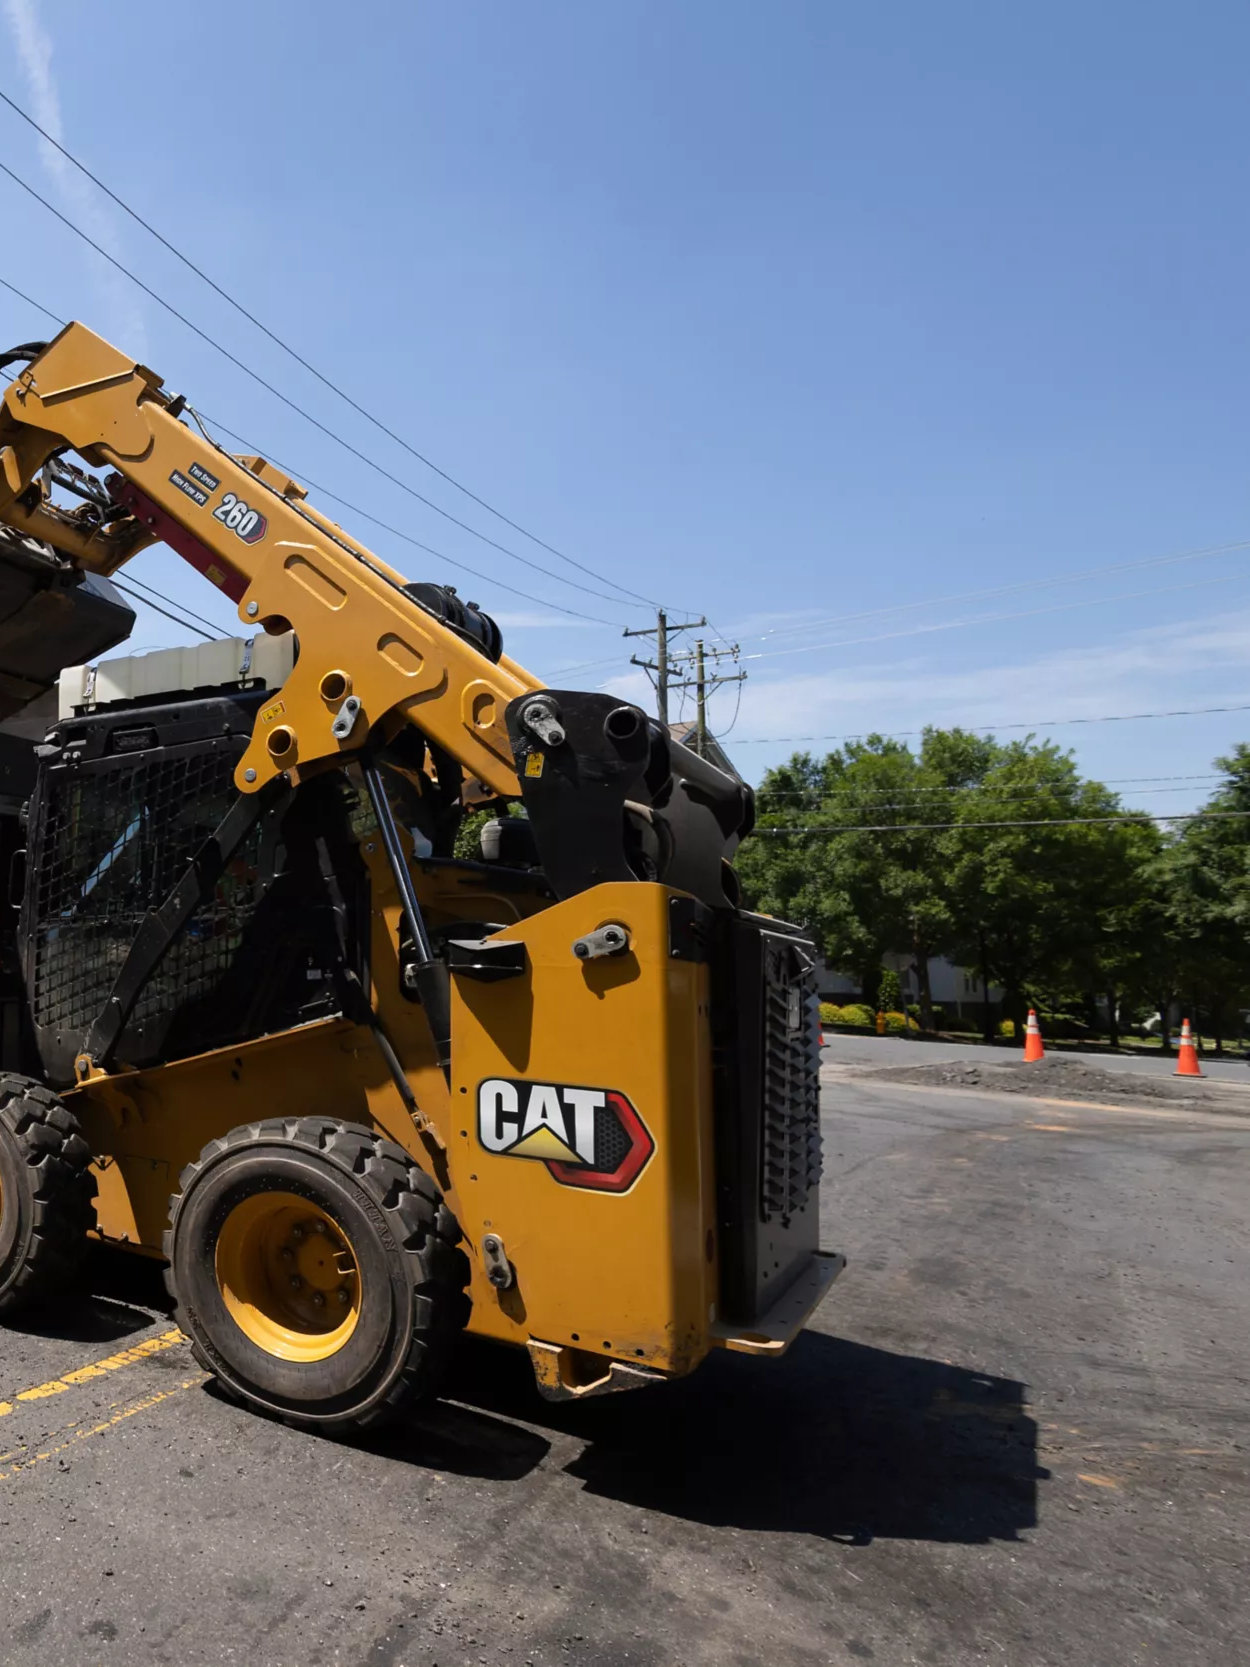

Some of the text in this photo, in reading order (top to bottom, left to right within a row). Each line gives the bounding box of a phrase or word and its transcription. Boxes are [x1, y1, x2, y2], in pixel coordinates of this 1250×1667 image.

[171, 474, 208, 504] HIGH FLOW XPS
[189, 466, 218, 489] TWO SPEED
[213, 493, 259, 537] 260
[480, 1079, 607, 1165] CAT
[352, 1188, 399, 1253] TITAN
